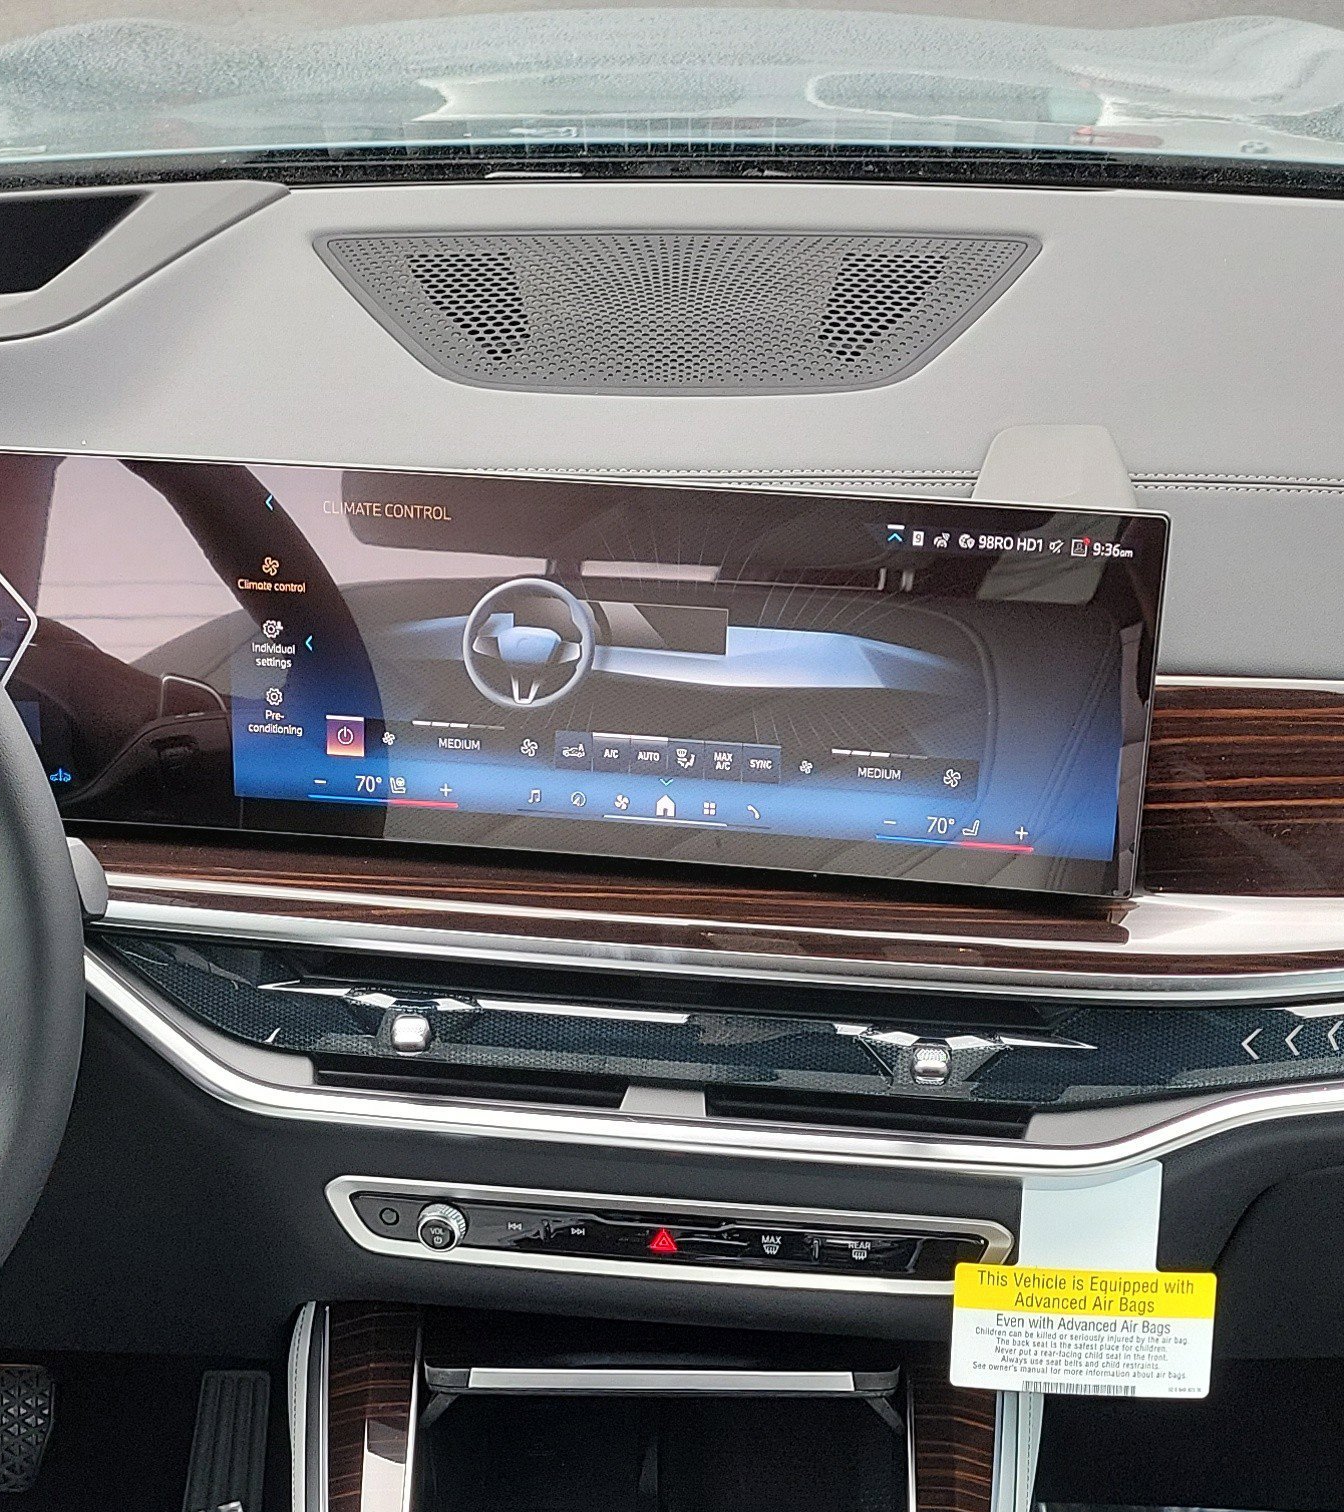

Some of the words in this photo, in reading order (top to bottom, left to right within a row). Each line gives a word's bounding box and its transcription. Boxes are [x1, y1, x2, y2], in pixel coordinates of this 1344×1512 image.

[323, 501, 381, 517] CLIMATE
[385, 503, 451, 520] CONTROL
[1017, 537, 1043, 552] HD1
[237, 578, 272, 591] Climate
[274, 581, 306, 593] control
[252, 643, 296, 655] Individual
[255, 657, 292, 669] settings
[248, 724, 303, 736] conditioning
[438, 738, 481, 750] MEDIUM
[637, 751, 660, 762] AUTO
[714, 752, 733, 762] MAX
[750, 759, 772, 770] SYNC
[857, 767, 902, 781] MEDIUM
[761, 1236, 782, 1245] MAX
[978, 1269, 1008, 1287] This
[1014, 1271, 1066, 1290] Vehicle
[1072, 1275, 1084, 1291] is
[1090, 1275, 1159, 1296] Equipped
[1164, 1279, 1194, 1294] with
[1014, 1291, 1087, 1310] Advanced
[1092, 1295, 1114, 1312] Air
[1119, 1296, 1155, 1316] Bags
[996, 1313, 1025, 1328] Even
[1028, 1316, 1054, 1330] with
[1057, 1317, 1117, 1333] Advanced
[1120, 1320, 1138, 1333] Air
[1142, 1320, 1171, 1337] Bags
[975, 1326, 1007, 1337] Children
[1024, 1330, 1034, 1339] be
[1036, 1331, 1057, 1340] killed
[1070, 1333, 1105, 1343] seriously
[1107, 1335, 1134, 1344] injured
[1136, 1336, 1145, 1345] by
[1148, 1336, 1159, 1344] the
[996, 1337, 1010, 1346] The
[1012, 1339, 1029, 1347] back
[1033, 1340, 1048, 1348] seat
[1050, 1340, 1057, 1348] is
[1059, 1341, 1072, 1349] the
[1074, 1341, 1097, 1351] safest
[1099, 1343, 1119, 1353] place
[994, 1345, 1017, 1354] Never
[1019, 1348, 1032, 1356] put
[1040, 1349, 1082, 1360] rear-facing
[1084, 1352, 1103, 1360] child
[1133, 1353, 1145, 1361] the
[1000, 1355, 1027, 1365] Always
[1030, 1358, 1043, 1366] use
[1064, 1359, 1083, 1368] belts
[1085, 1360, 1099, 1368] and
[972, 1361, 986, 1370] See
[988, 1364, 1017, 1373] owner's
[1020, 1366, 1048, 1374] manual
[1063, 1368, 1083, 1376] more
[1085, 1369, 1130, 1378] information
[1132, 1371, 1154, 1379] about
[1156, 1371, 1166, 1379] air
